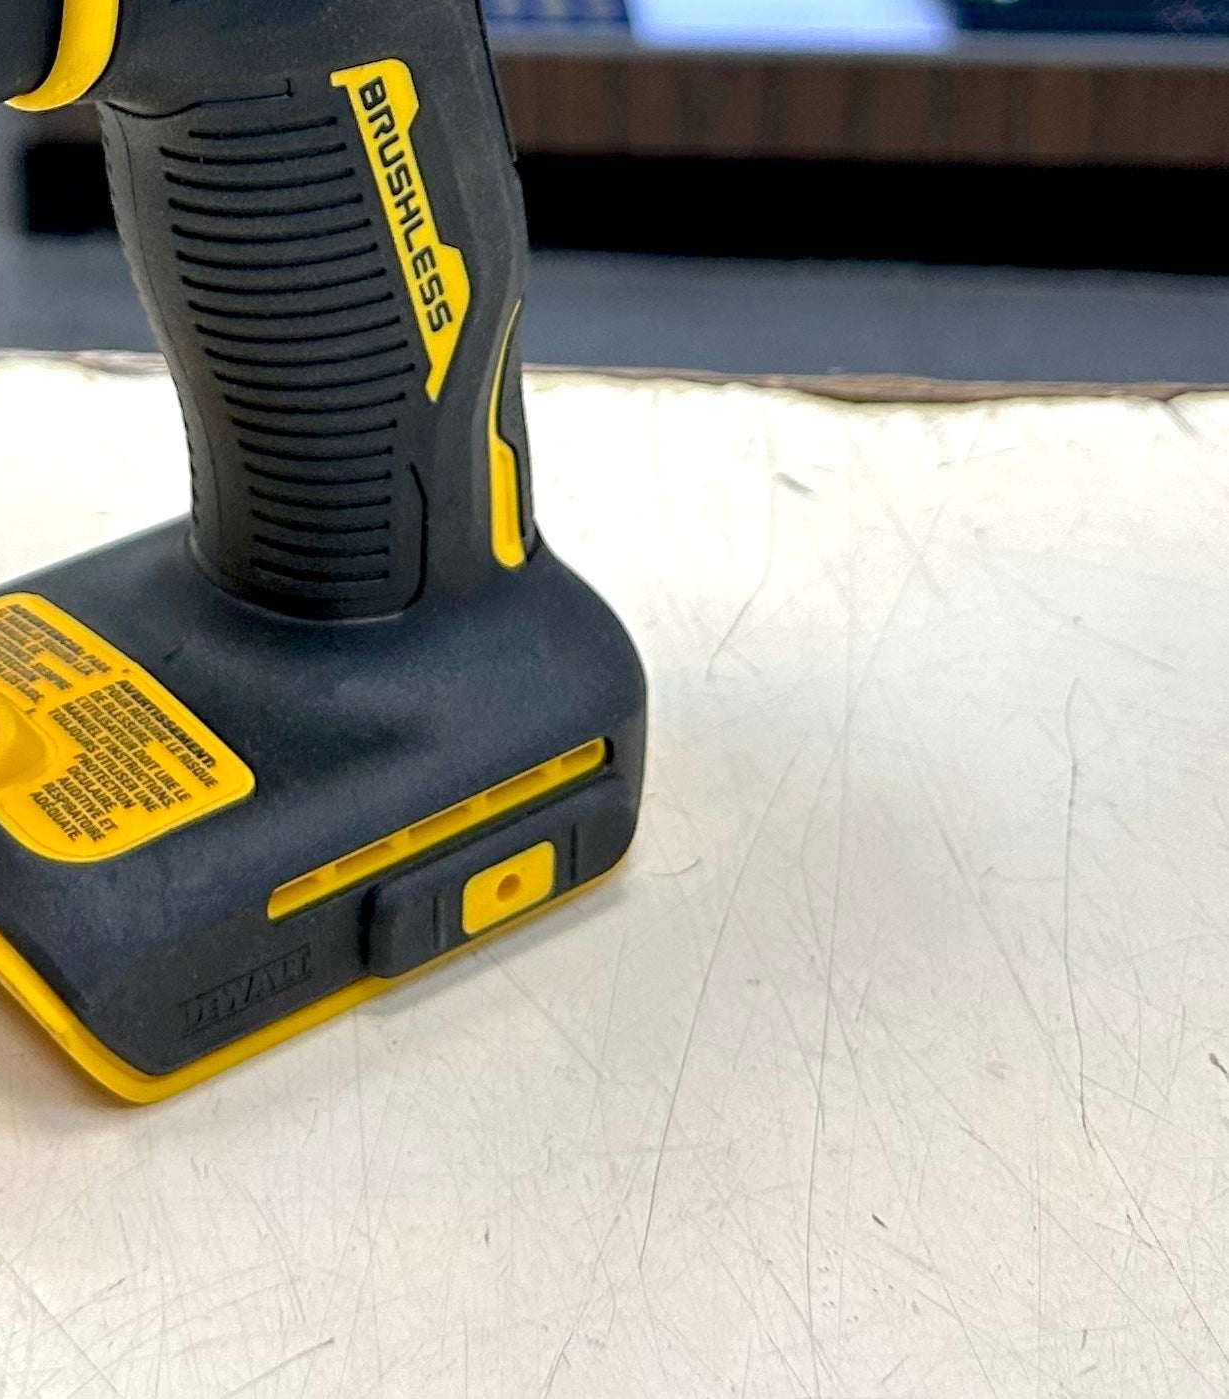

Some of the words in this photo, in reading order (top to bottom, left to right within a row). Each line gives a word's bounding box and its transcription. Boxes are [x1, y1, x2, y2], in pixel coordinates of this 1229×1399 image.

[358, 76, 453, 333] BRUSHLESS
[89, 690, 109, 704] DE
[48, 707, 101, 754] TOUJOURS
[93, 751, 140, 793] UTILISER
[133, 789, 161, 813] UNE
[102, 684, 134, 710] POUR
[165, 741, 185, 755] LE
[177, 752, 219, 788] RISQUE
[56, 775, 105, 820] AUDITIVE
[98, 817, 119, 831] ET
[73, 752, 137, 810] PROTECTION
[131, 748, 162, 771] DOIT
[154, 769, 181, 791] LIRE
[173, 788, 193, 803] LE
[42, 781, 107, 841] RESPIRATOIRE
